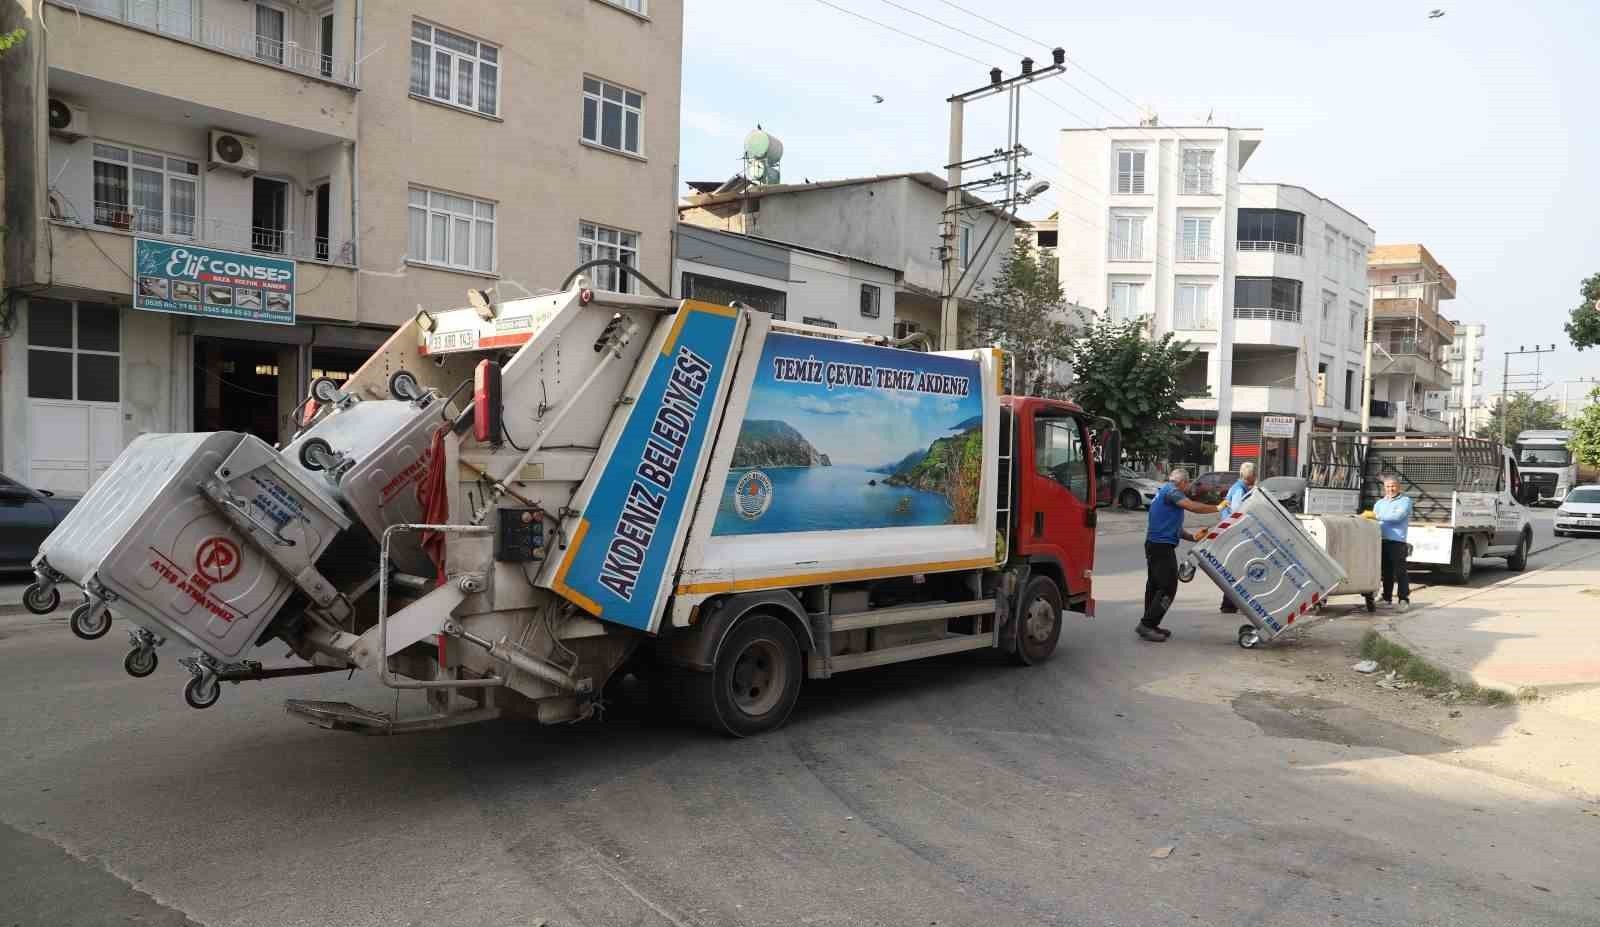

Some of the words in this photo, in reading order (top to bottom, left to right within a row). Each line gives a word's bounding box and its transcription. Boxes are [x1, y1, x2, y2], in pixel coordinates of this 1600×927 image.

[166, 248, 209, 279] Elif
[210, 260, 291, 281] CONSEP
[774, 354, 823, 383] TEMİZ
[826, 363, 874, 390] ÇEVRE
